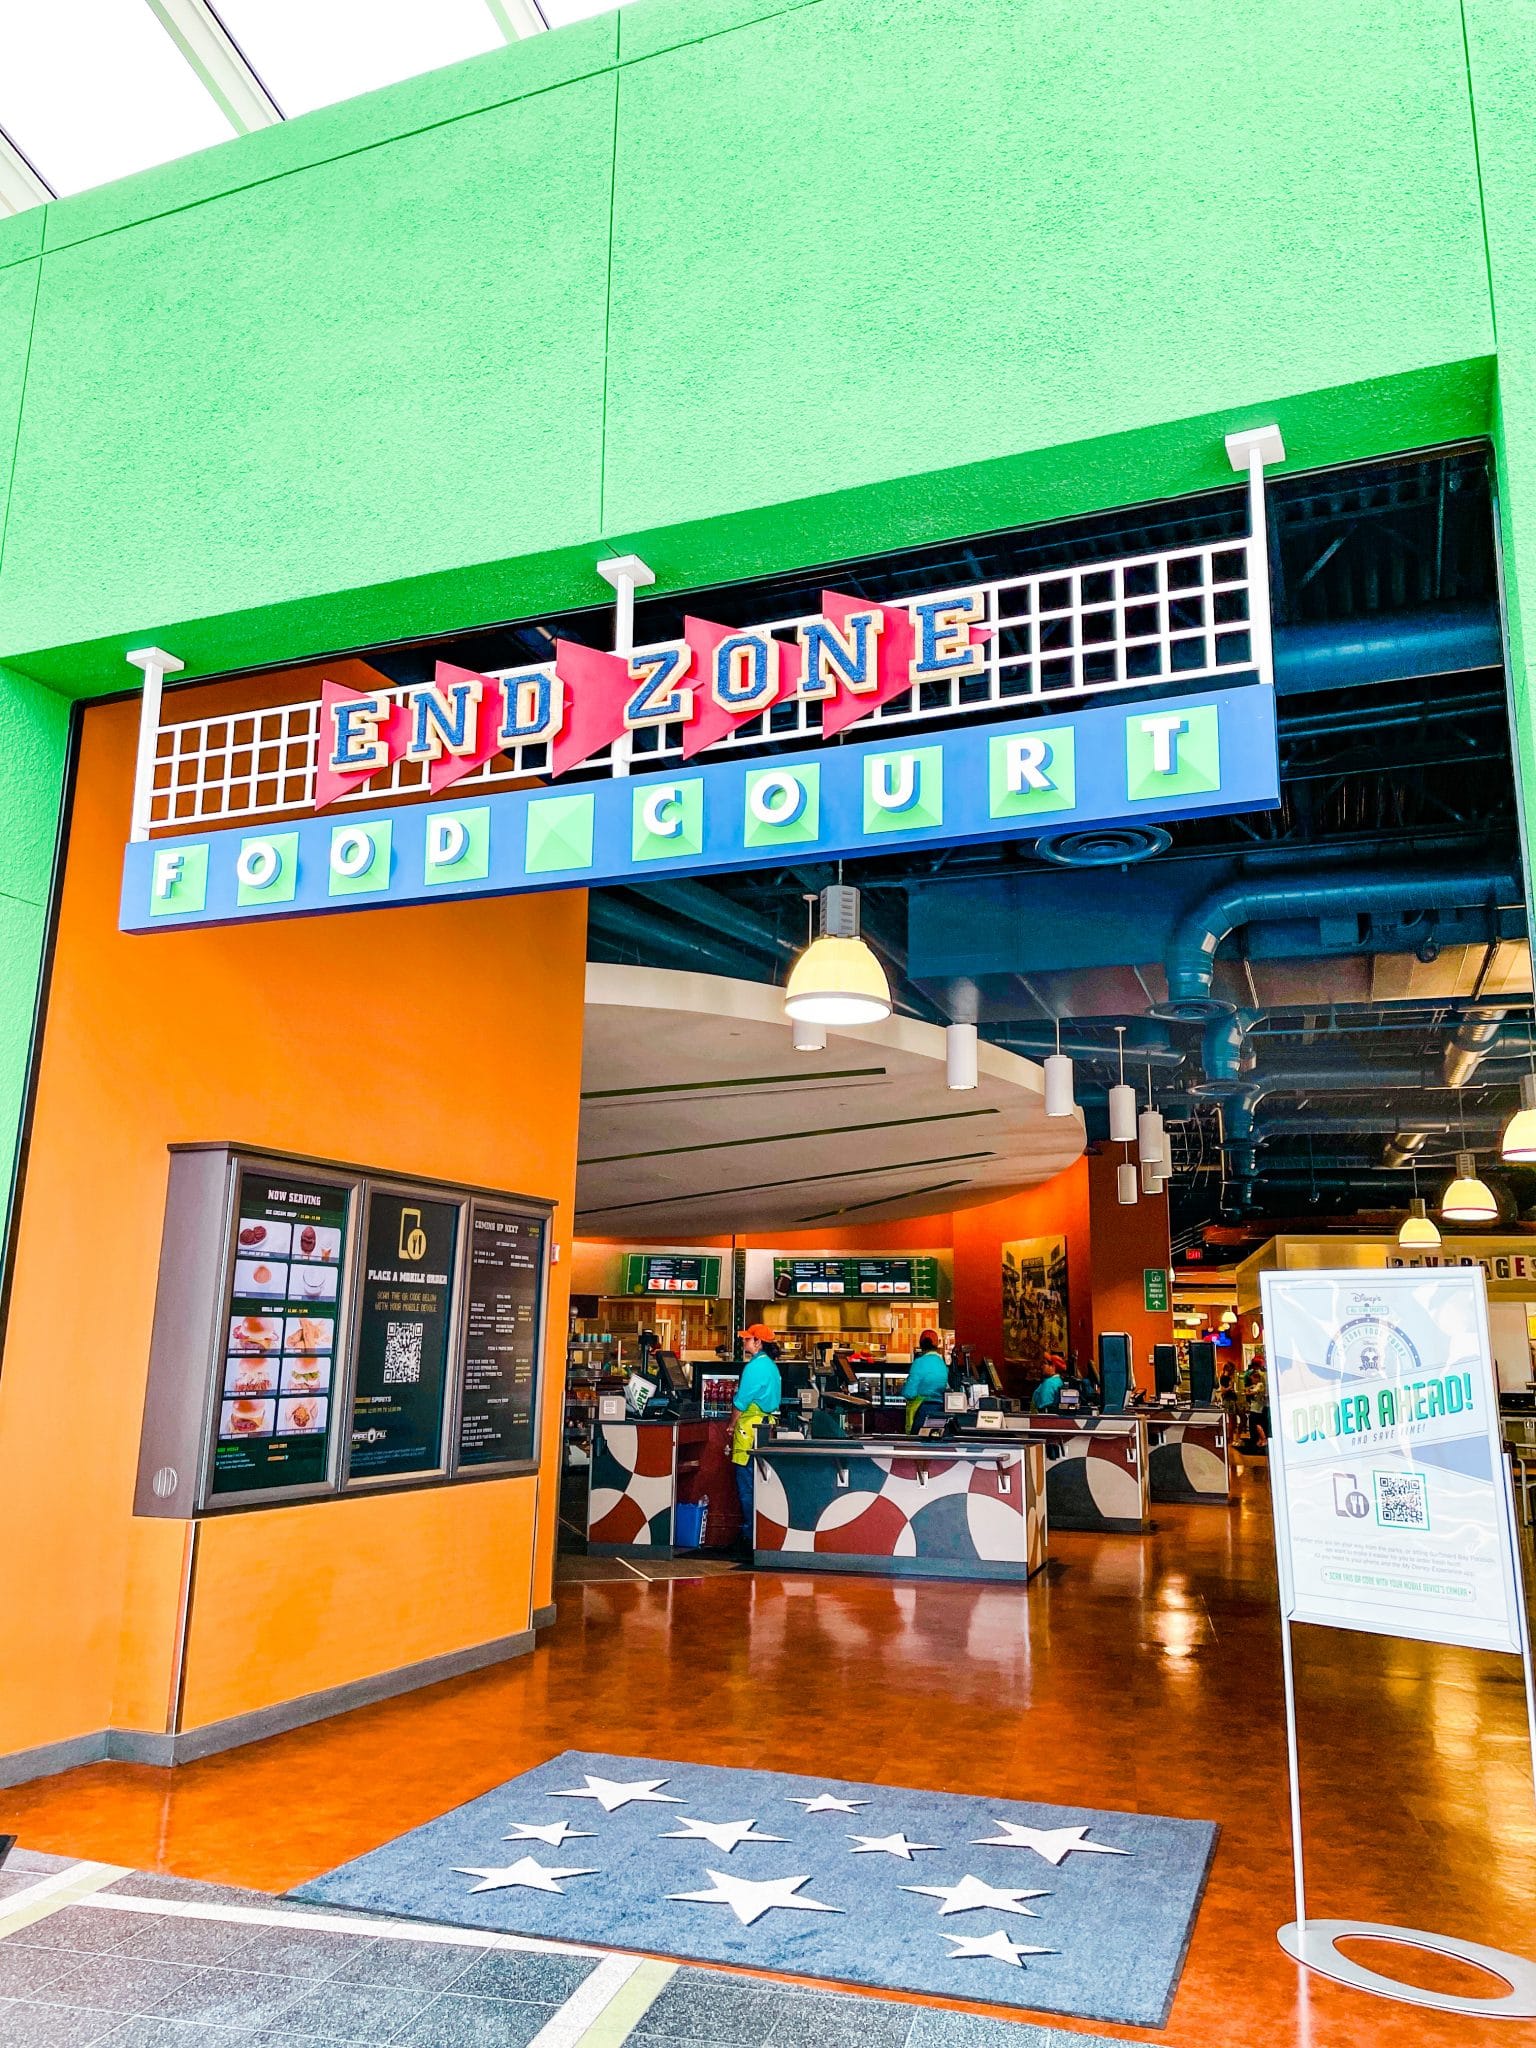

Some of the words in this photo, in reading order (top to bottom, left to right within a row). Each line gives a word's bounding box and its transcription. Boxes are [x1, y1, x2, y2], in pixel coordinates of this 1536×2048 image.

[329, 667, 565, 774] END
[623, 591, 985, 730] ZONE
[155, 817, 470, 899] FOOD
[642, 716, 1190, 838] COURT
[267, 1189, 287, 1203] NOW
[288, 1192, 322, 1206] SERVING
[368, 1269, 392, 1281] PLACE
[392, 1271, 398, 1282] A
[1292, 1394, 1372, 1444] ORDER
[1377, 1371, 1474, 1428] AHEAD!
